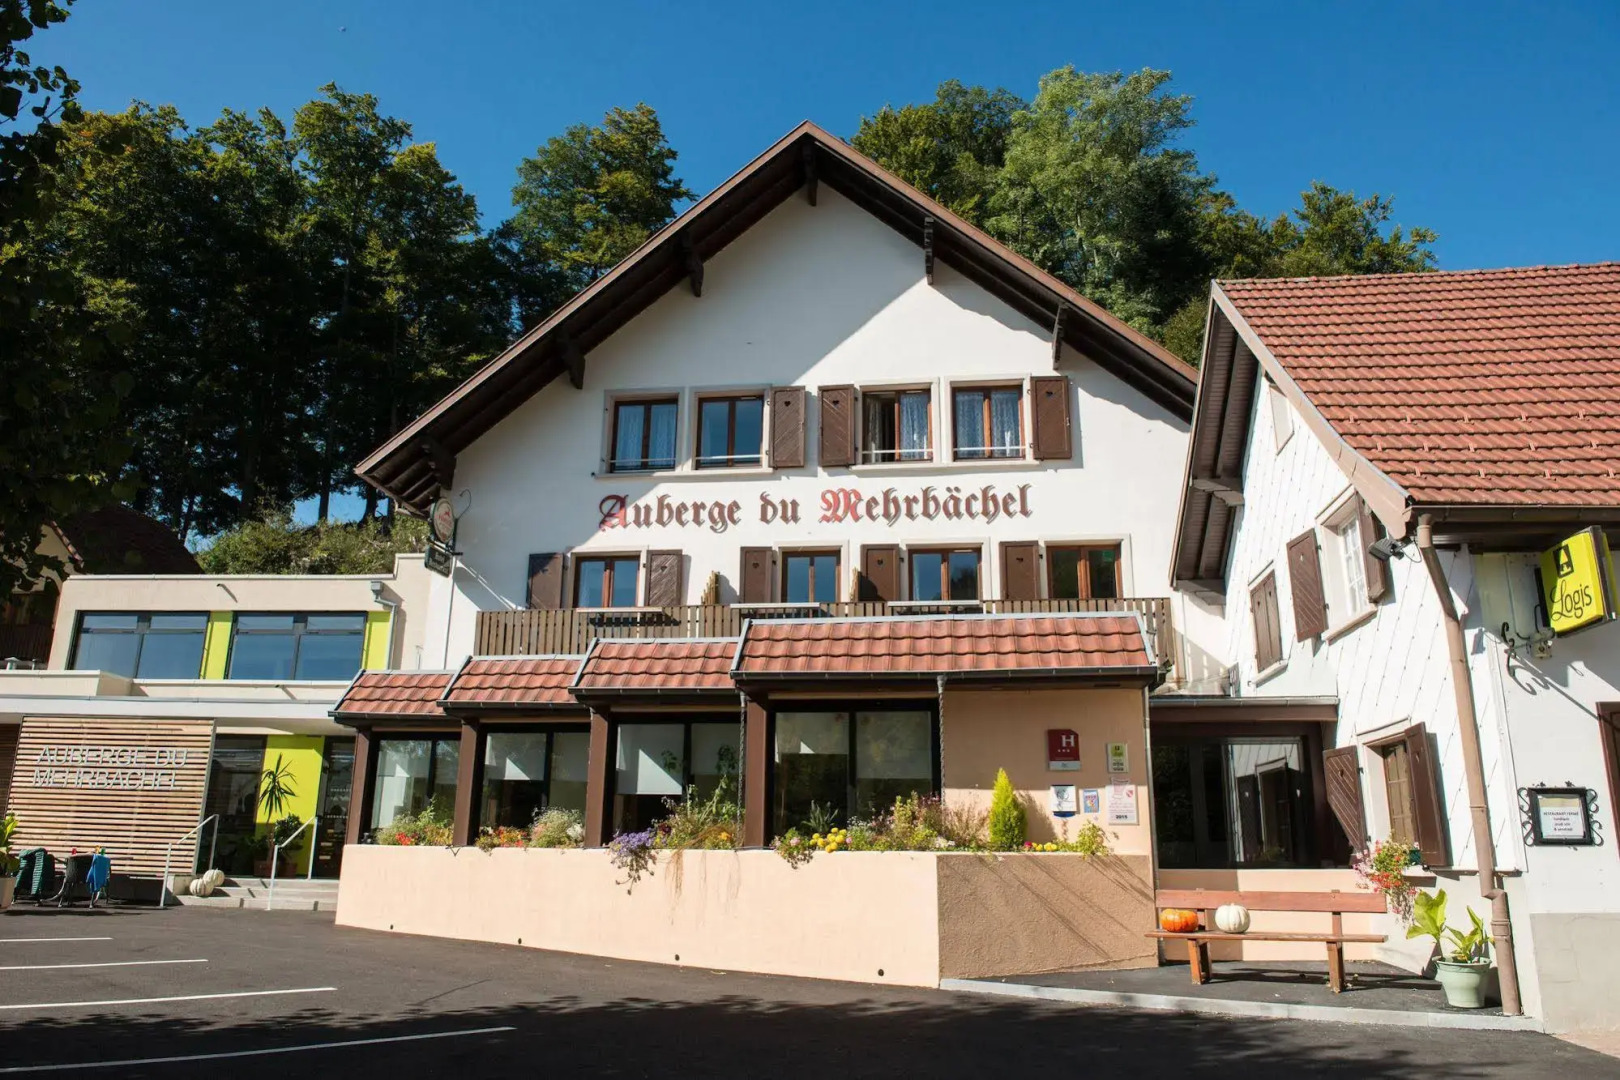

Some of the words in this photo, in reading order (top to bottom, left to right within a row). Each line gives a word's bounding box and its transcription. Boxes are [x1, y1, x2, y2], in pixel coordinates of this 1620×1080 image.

[599, 493, 741, 533] Auberge
[759, 491, 801, 525] du
[818, 483, 1033, 527] Mehrbächel
[1549, 579, 1593, 622] Logis
[1061, 734, 1075, 748] H
[36, 745, 148, 767] AUBERGE
[154, 748, 189, 769] DU
[32, 767, 183, 790] MEHRBACHEL
